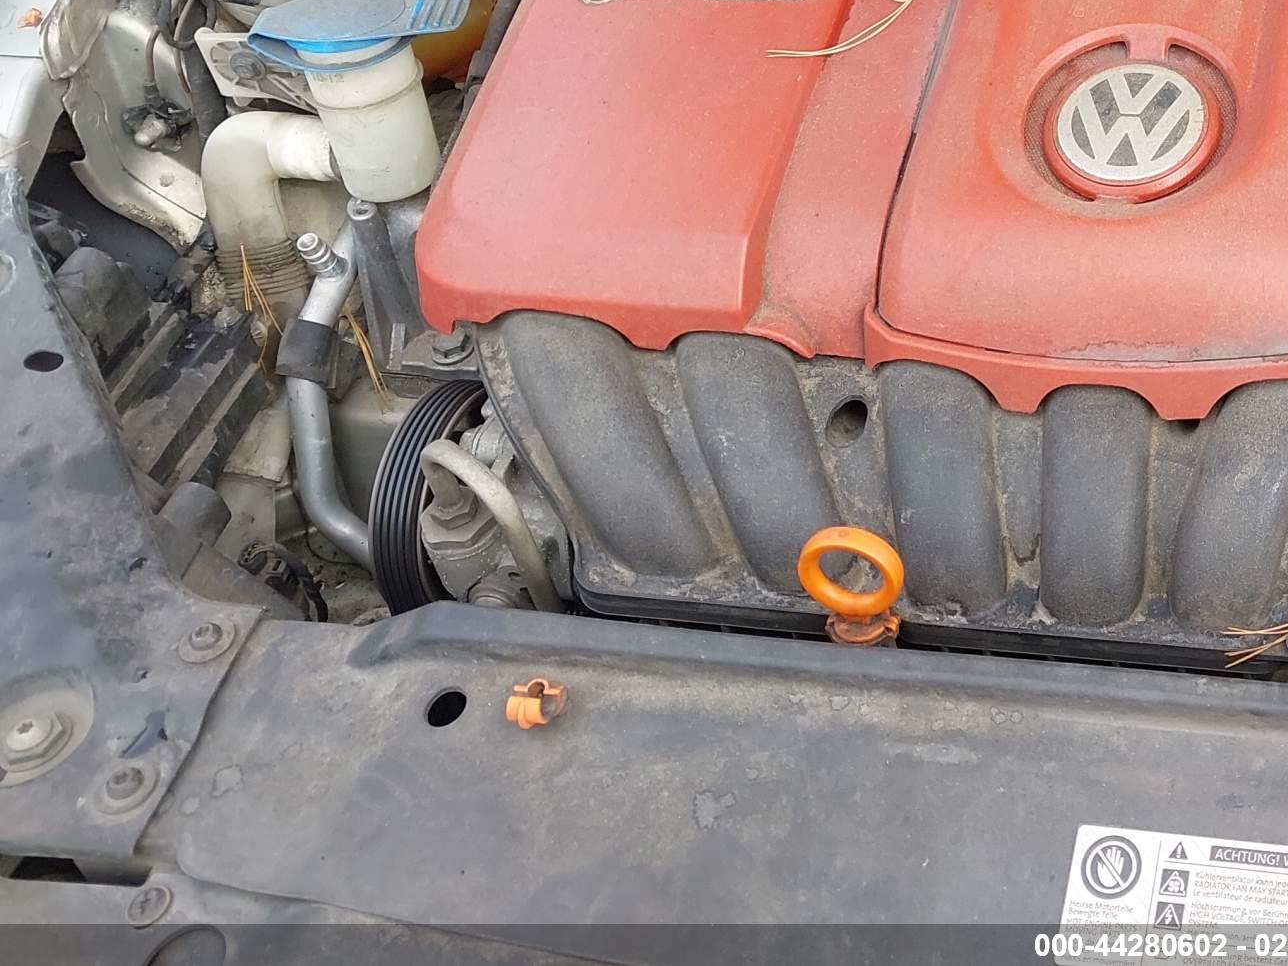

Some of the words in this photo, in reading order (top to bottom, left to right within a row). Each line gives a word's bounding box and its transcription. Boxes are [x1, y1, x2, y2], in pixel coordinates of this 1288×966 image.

[1058, 64, 1204, 181] VW
[1214, 848, 1280, 866] ACHTUNG!
[1194, 880, 1233, 891] RADIATOR
[1233, 885, 1248, 893] FAN
[1249, 886, 1268, 895] MAY
[1254, 896, 1288, 906] radiateur
